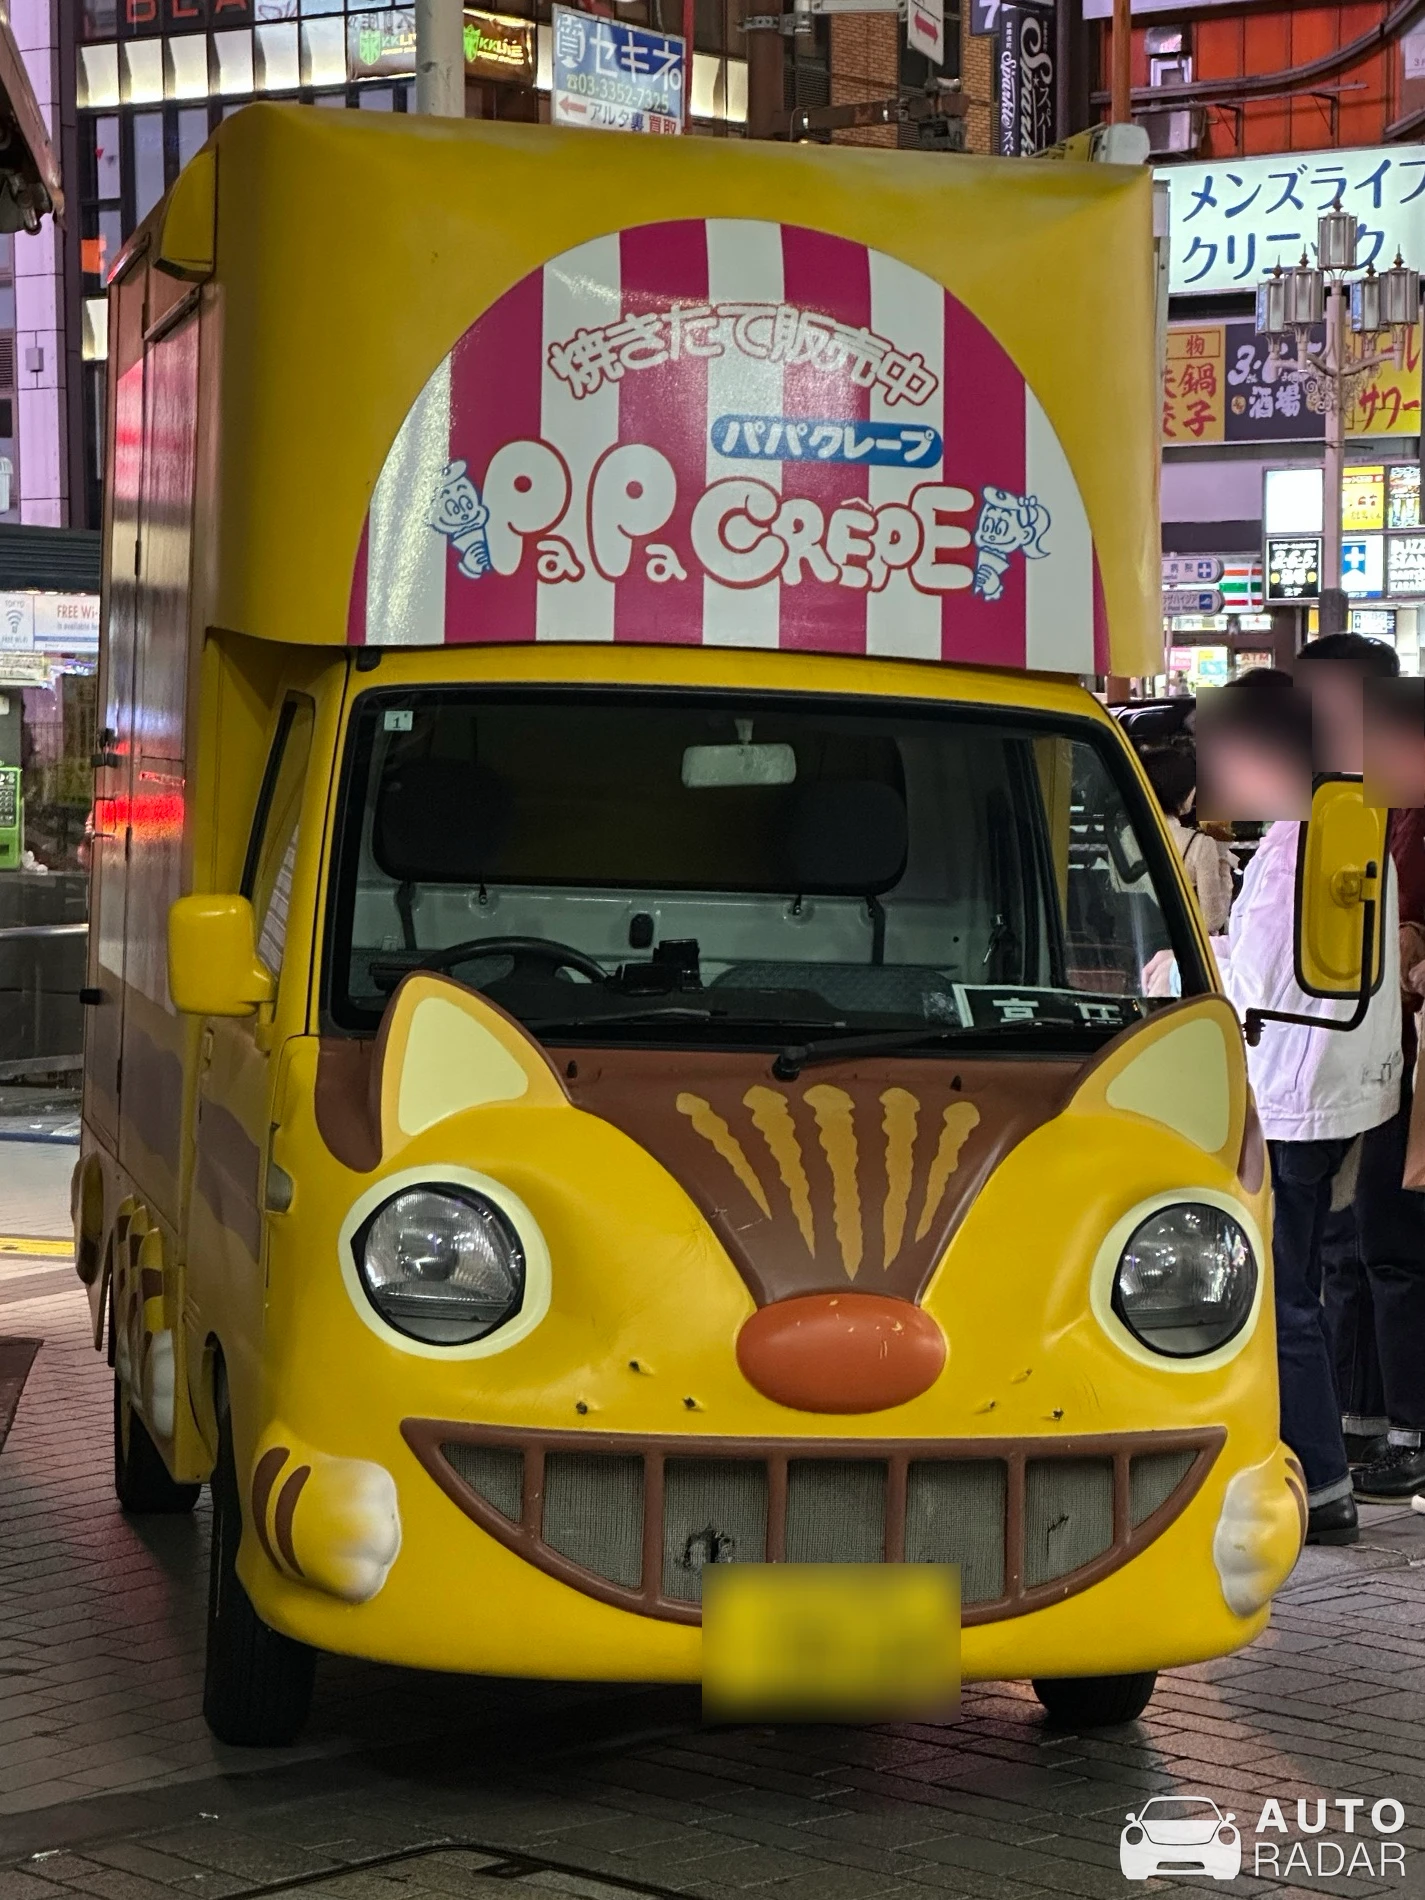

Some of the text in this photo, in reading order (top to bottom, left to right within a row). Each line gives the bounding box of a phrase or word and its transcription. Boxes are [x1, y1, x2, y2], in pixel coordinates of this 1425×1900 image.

[579, 74, 669, 113] 03-3352-7325
[1182, 222, 1385, 283] クリニク
[547, 302, 939, 406] 焼きたて販売中
[1249, 384, 1301, 418] 酒場
[1359, 383, 1420, 432] サワー
[722, 420, 935, 463] パパクレープ
[57, 605, 79, 618] FREE
